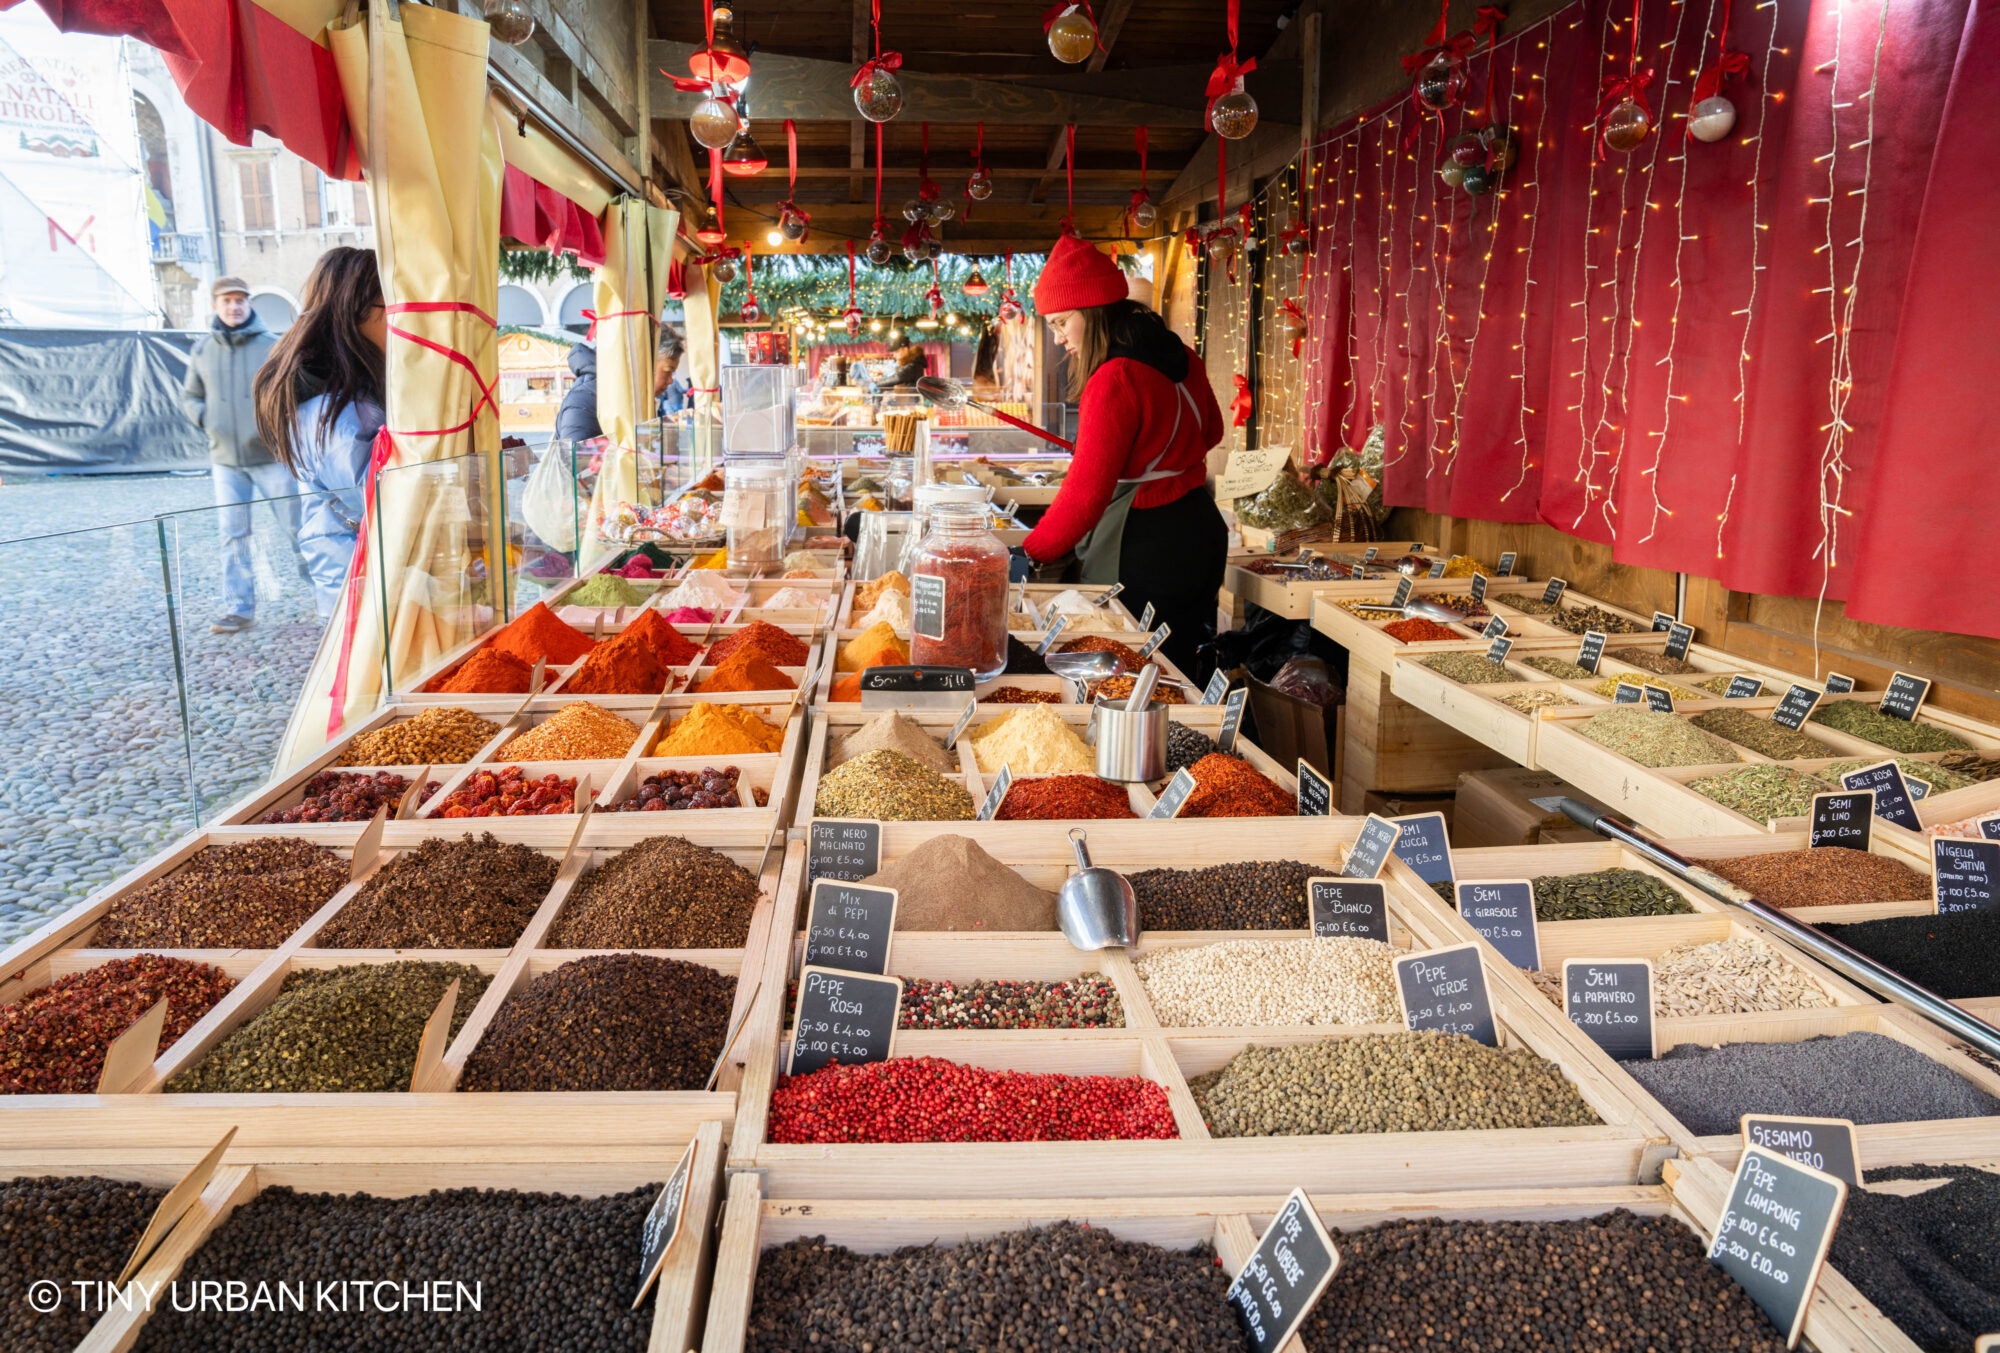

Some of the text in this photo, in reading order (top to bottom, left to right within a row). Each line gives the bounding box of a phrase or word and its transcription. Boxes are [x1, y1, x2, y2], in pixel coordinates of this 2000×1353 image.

[1849, 769, 1893, 789] SALE ROSA
[1828, 798, 1852, 810] SEMI
[1820, 812, 1850, 822] di LINO
[812, 824, 867, 839] PEPE NERO
[820, 841, 865, 851] MACINATO
[1400, 837, 1428, 848] ZUCCA
[1937, 842, 1975, 859] NIGELLA
[1954, 859, 1985, 871] SATIVA
[1313, 885, 1343, 899] PEPE
[1473, 886, 1501, 902] SEMI
[828, 906, 868, 920] di PEPI
[1330, 900, 1373, 914] BIANCO
[1463, 907, 1518, 918] di GIRASOLE
[1410, 961, 1447, 984] PEPE
[1585, 968, 1618, 986] SEMI
[808, 973, 844, 996] PEPE
[1432, 979, 1468, 997] VERDE
[1572, 991, 1635, 1003] di PAPAVERO
[828, 997, 863, 1016] ROSA
[1751, 1126, 1813, 1149] SESAMO
[1744, 1157, 1777, 1193] PEPE
[1744, 1187, 1801, 1231] LAMPONG
[1281, 1199, 1302, 1244] PEPE
[1274, 1236, 1304, 1287] CUBEBE
